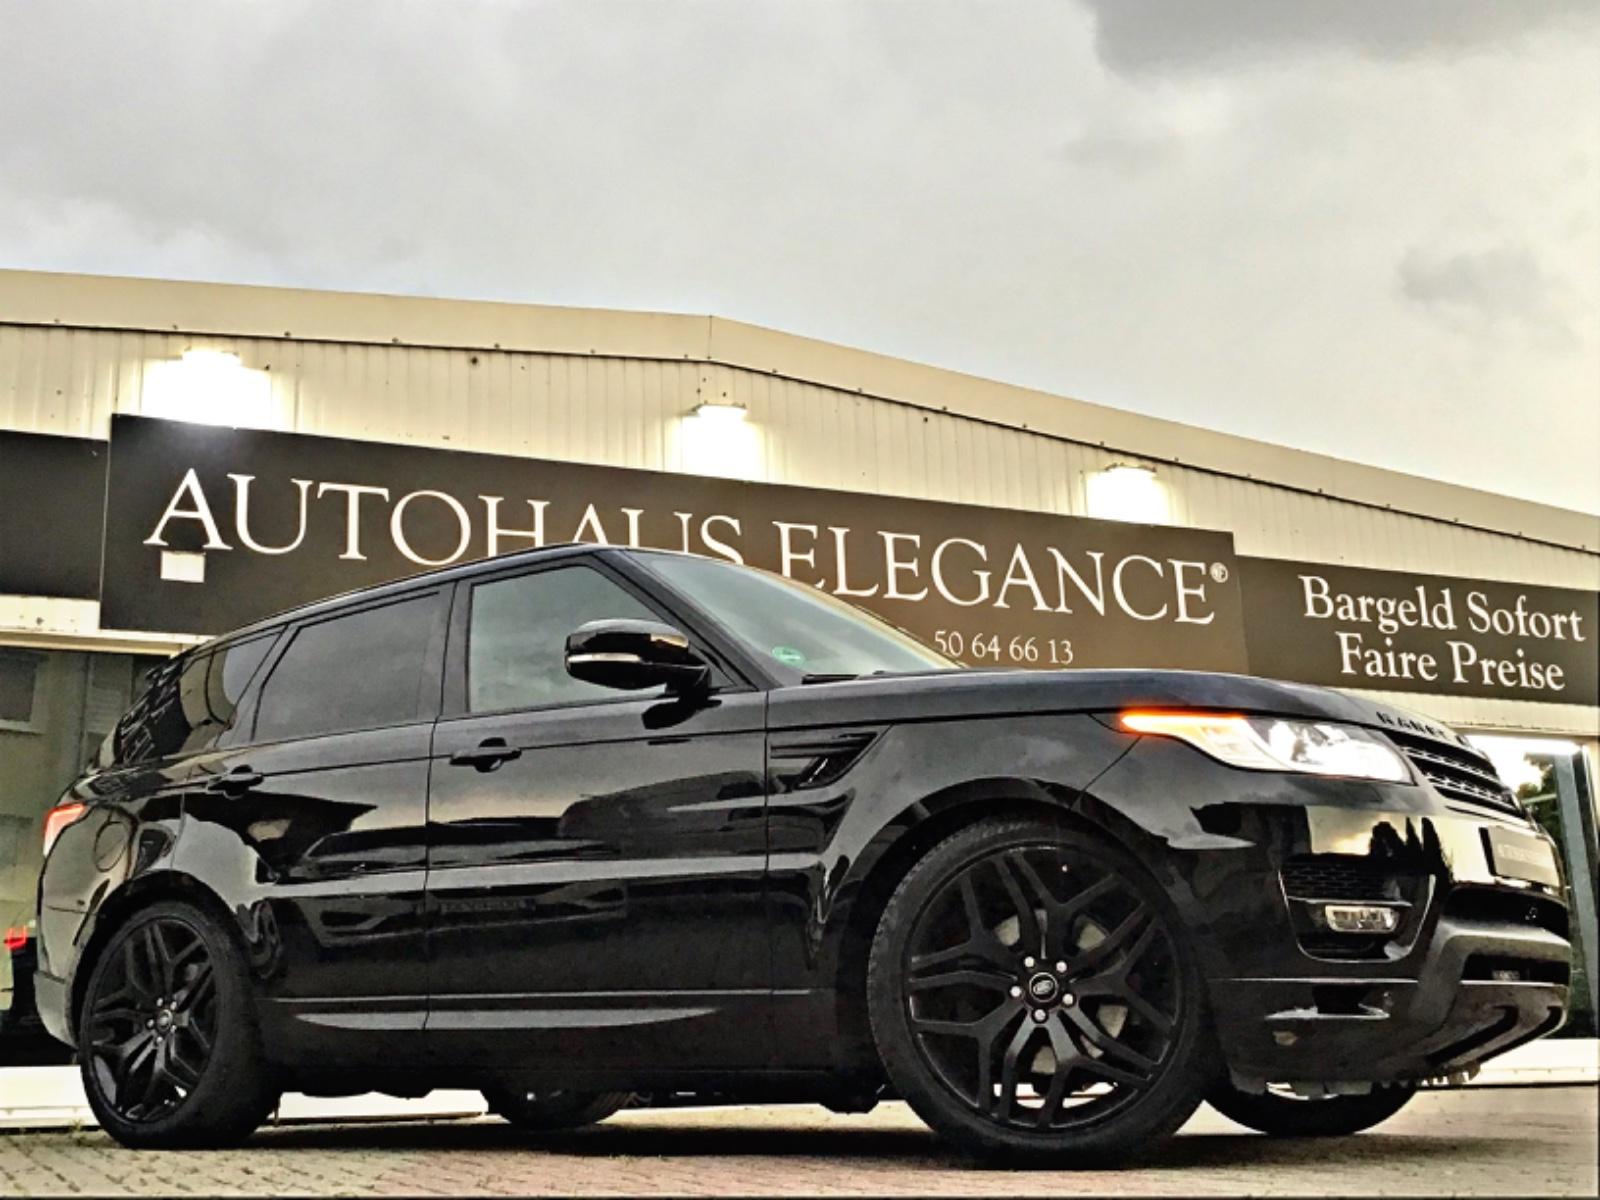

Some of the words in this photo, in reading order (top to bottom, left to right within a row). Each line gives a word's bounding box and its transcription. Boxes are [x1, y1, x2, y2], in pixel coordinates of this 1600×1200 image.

[1298, 575, 1457, 634] Bargeld
[1466, 591, 1586, 642] Sofort
[934, 630, 964, 657] 50
[971, 633, 1001, 662] 64
[1009, 635, 1039, 662] 66
[1048, 639, 1073, 665] 13
[1335, 632, 1438, 681] Faire
[1447, 641, 1565, 691] Preise
